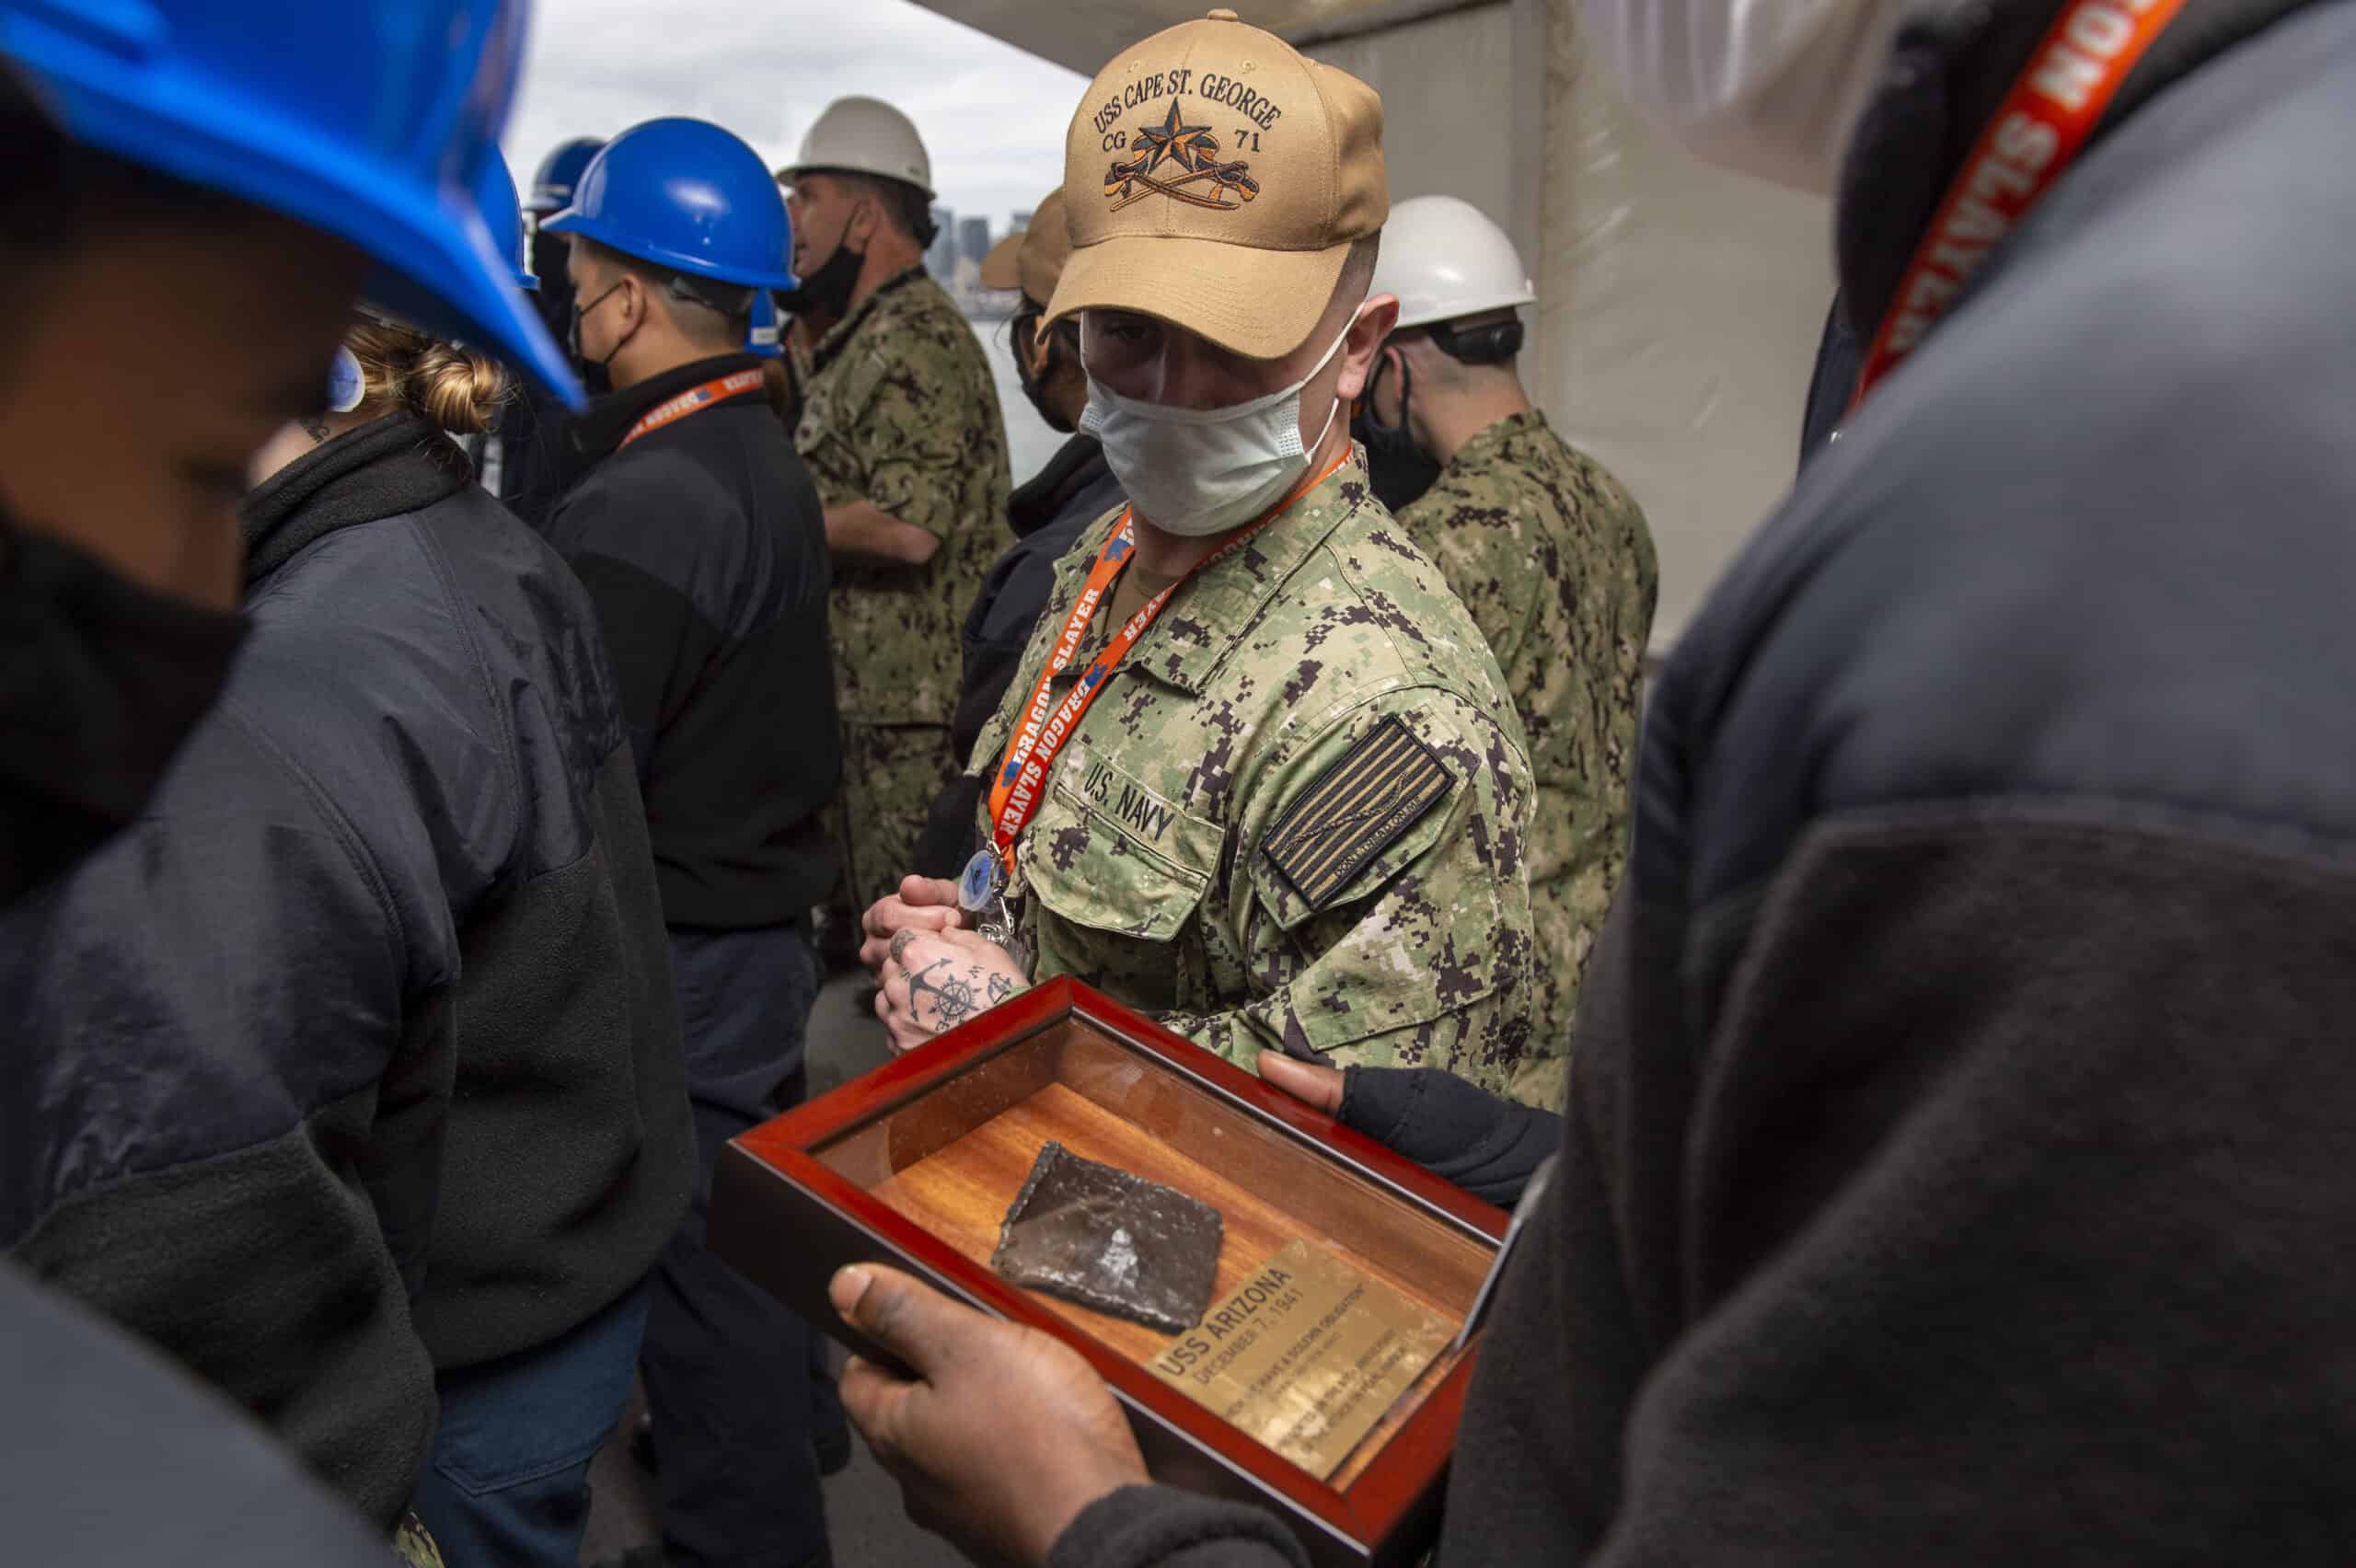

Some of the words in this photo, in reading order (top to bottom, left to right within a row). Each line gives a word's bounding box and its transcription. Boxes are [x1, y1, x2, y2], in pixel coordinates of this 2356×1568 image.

[1092, 96, 1123, 134] USS
[1124, 73, 1164, 108] CAPE
[1166, 69, 1194, 96] ST.
[1199, 73, 1282, 132] GEORGE
[1102, 131, 1128, 152] CG
[1234, 129, 1261, 152] 71
[1051, 587, 1101, 672] SLAYER
[1034, 676, 1092, 762] DRAGON
[999, 760, 1044, 836] SLAYER
[1084, 761, 1110, 806] U.S.
[1114, 783, 1175, 842] NAVY
[1157, 1335, 1211, 1378] USS
[1204, 1266, 1292, 1341] ARIZONA
[1192, 1327, 1259, 1385] DECEMBER
[1269, 1287, 1305, 1316] 1941
